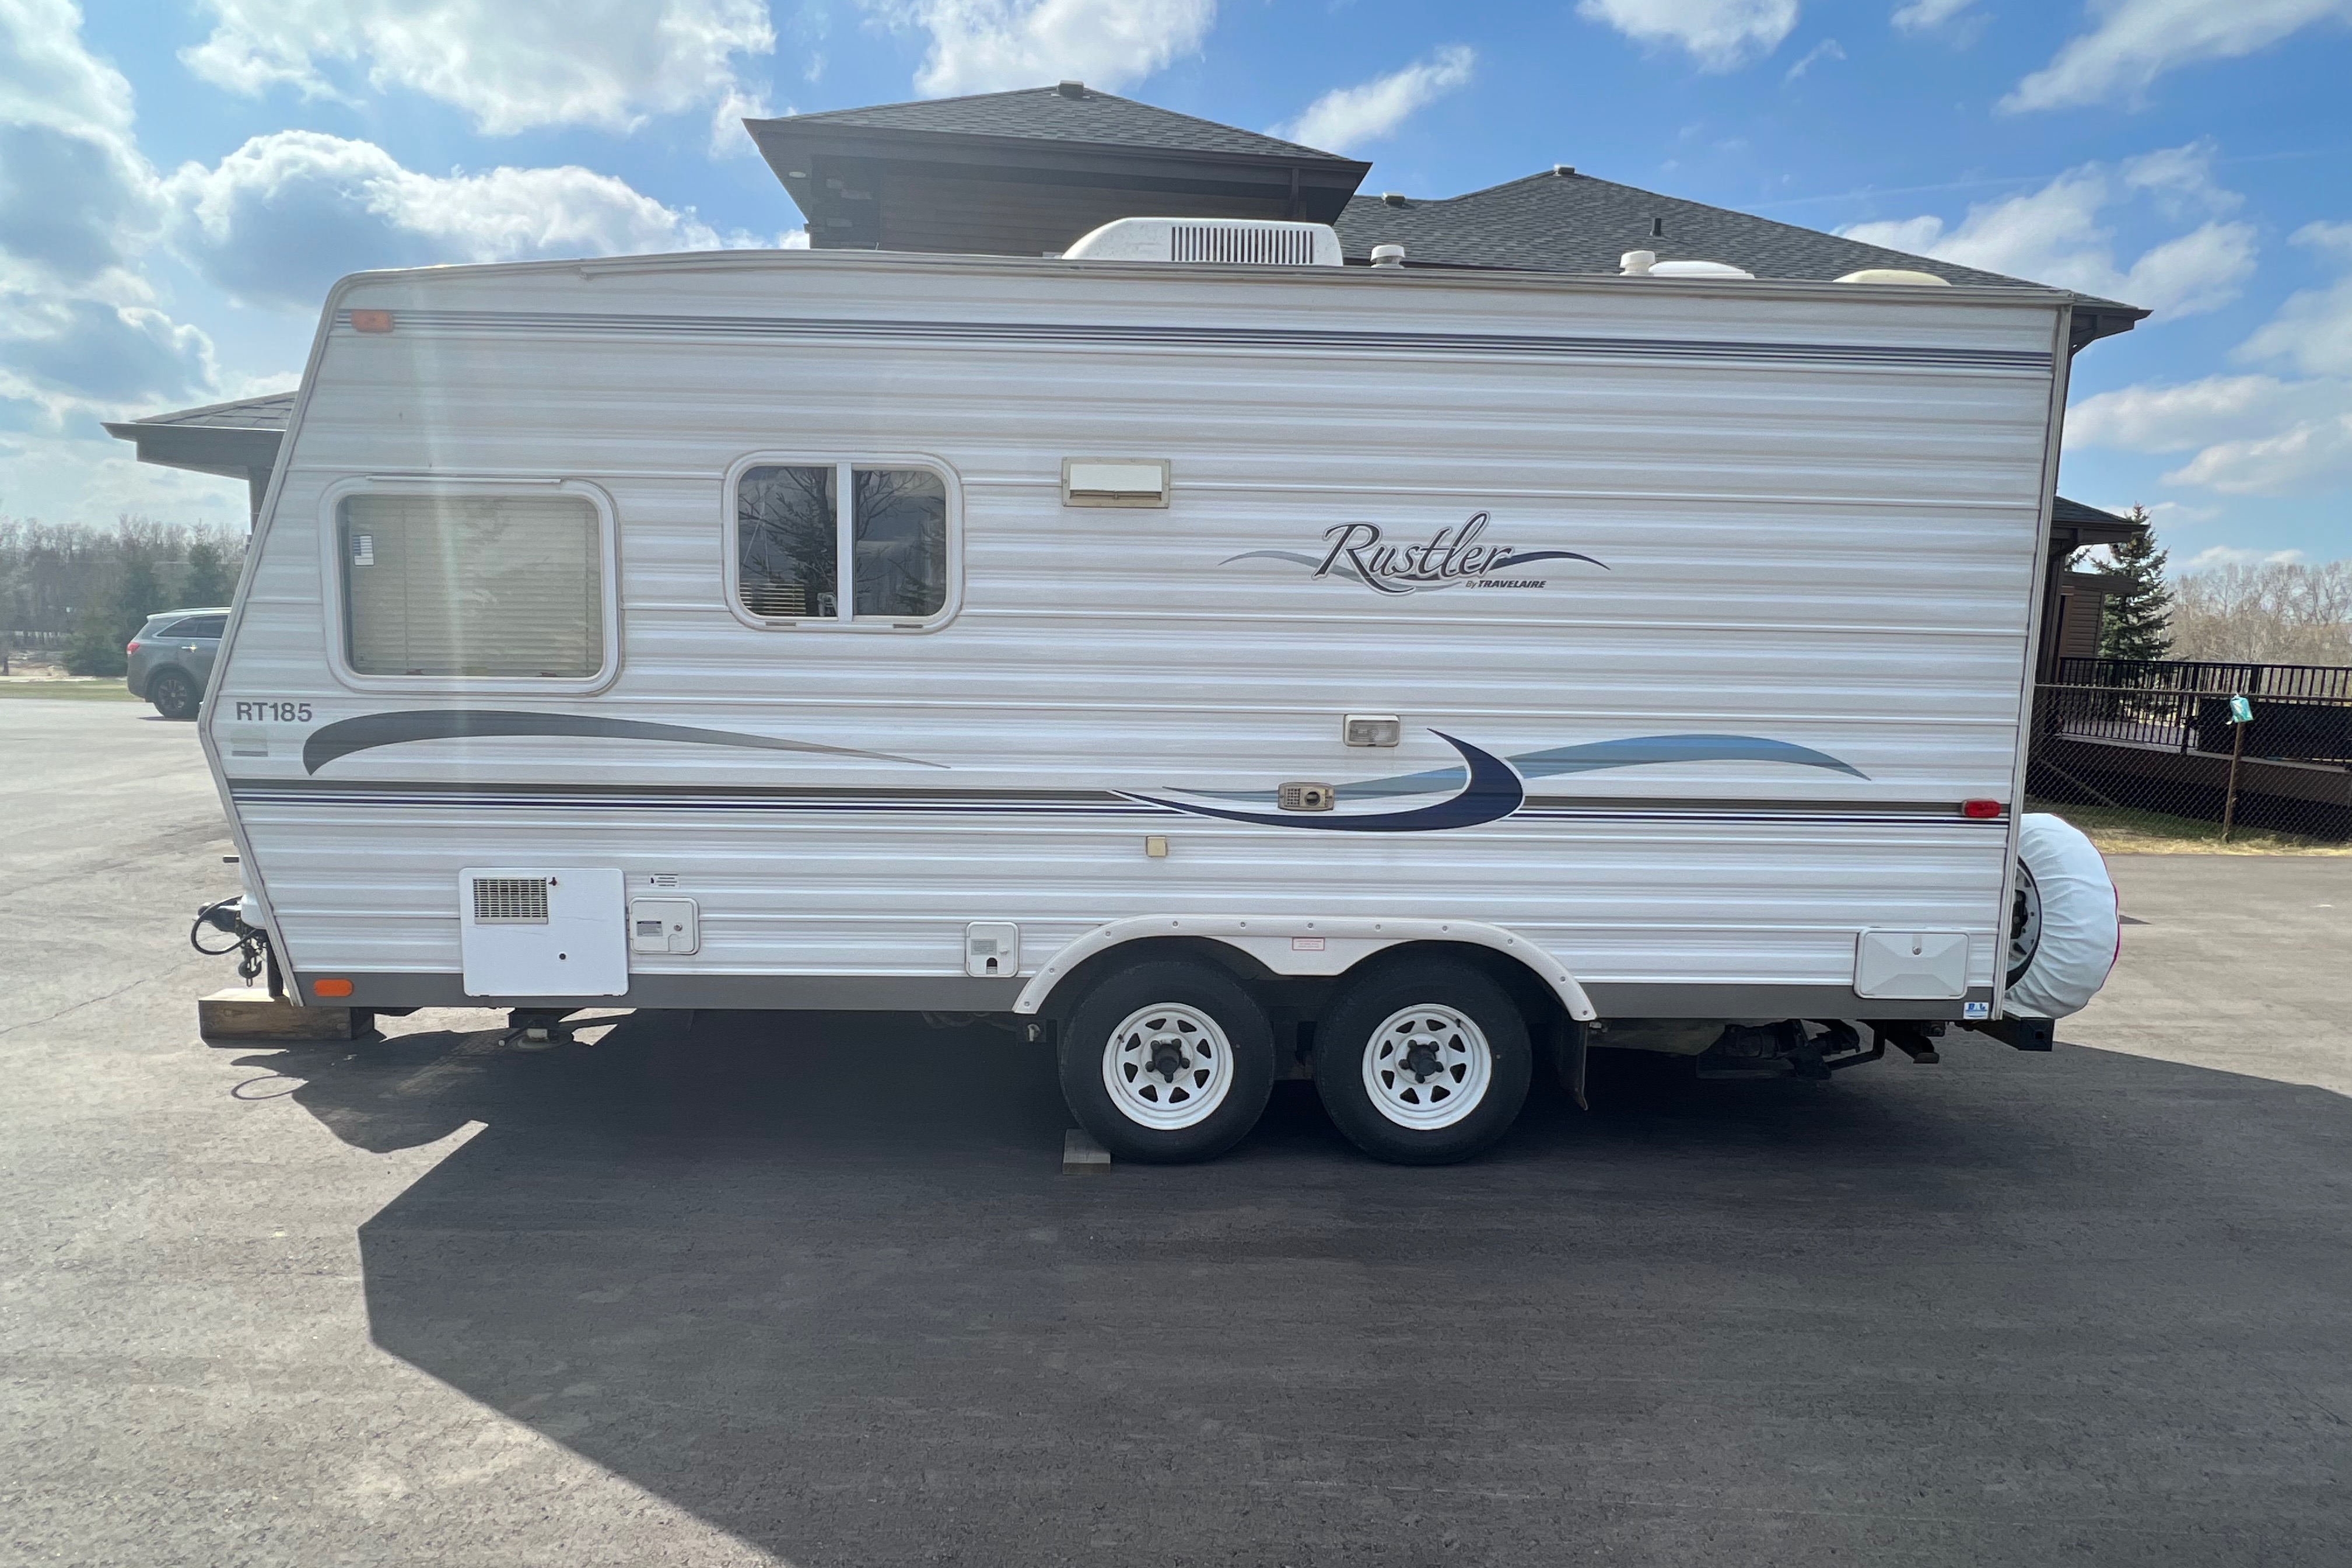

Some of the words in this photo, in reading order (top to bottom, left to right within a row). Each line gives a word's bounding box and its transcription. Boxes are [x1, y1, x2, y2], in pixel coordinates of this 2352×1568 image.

[1312, 512, 1514, 595] Rustler
[1465, 580, 1477, 589] By
[1478, 580, 1546, 588] TRAVELAIRE
[236, 701, 313, 722] RT185
